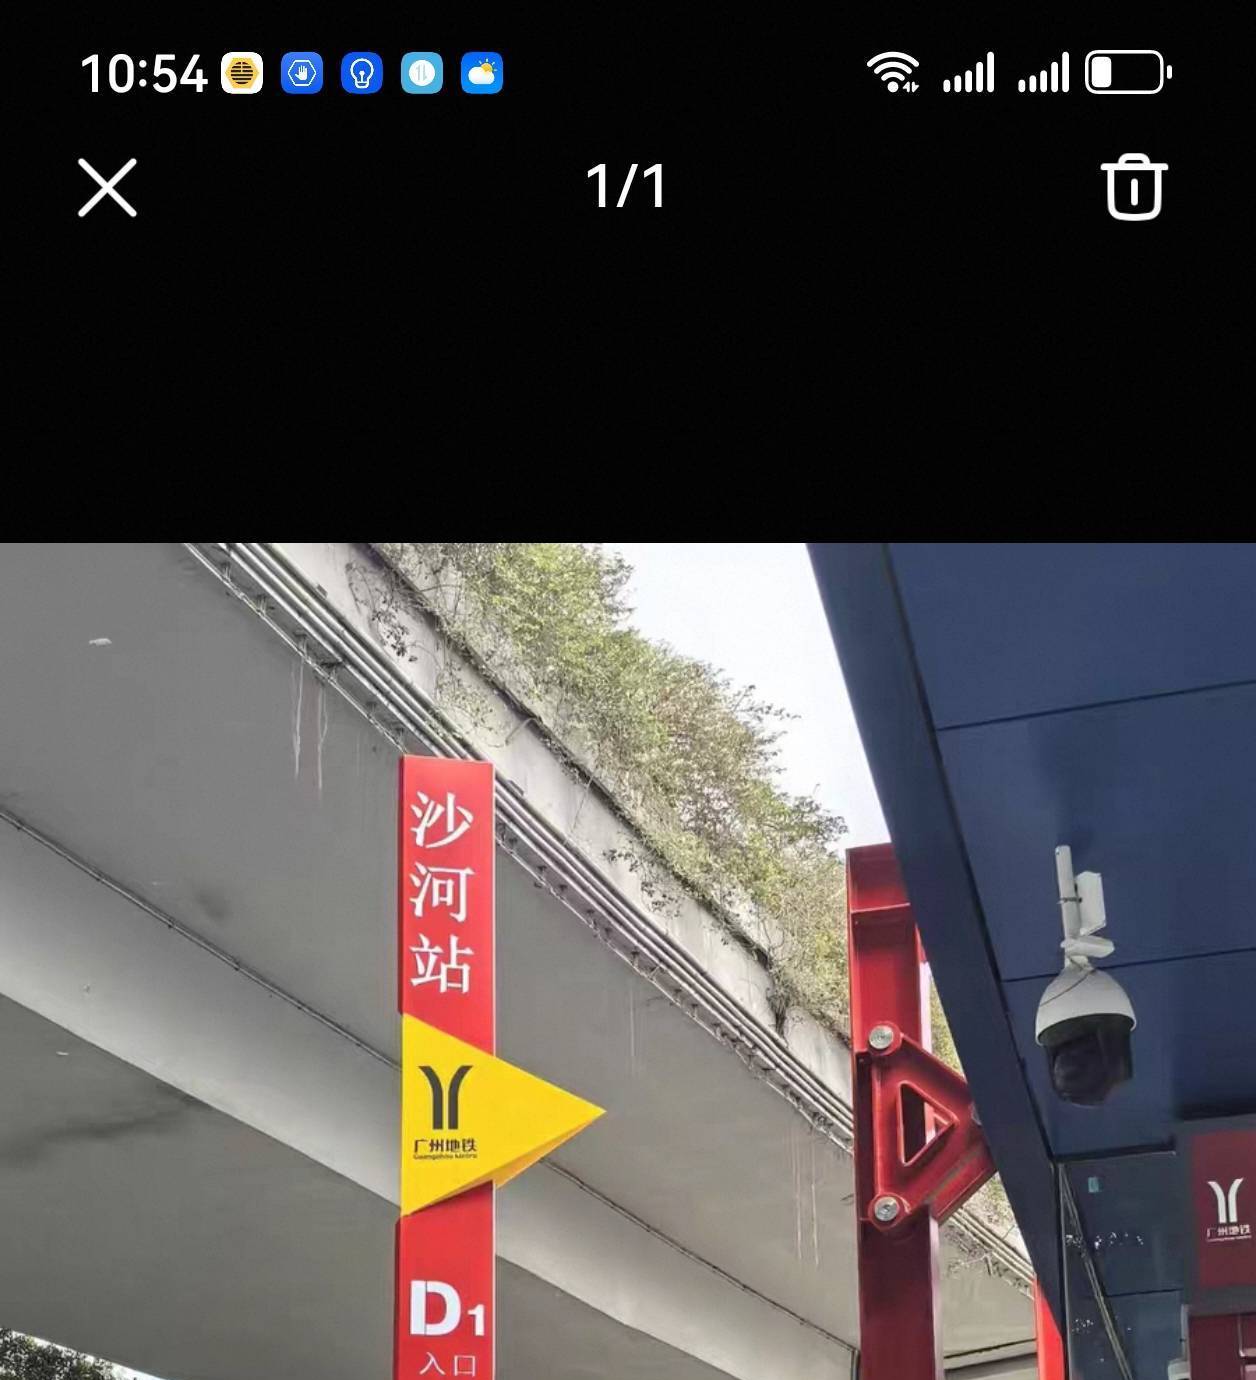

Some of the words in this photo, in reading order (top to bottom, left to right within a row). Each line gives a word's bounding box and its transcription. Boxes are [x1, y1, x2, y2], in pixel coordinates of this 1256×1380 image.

[409, 791, 475, 994] 沙河站
[413, 1138, 477, 1153] 广州地铁
[410, 1280, 485, 1336] D1
[419, 1352, 477, 1377] 入口
